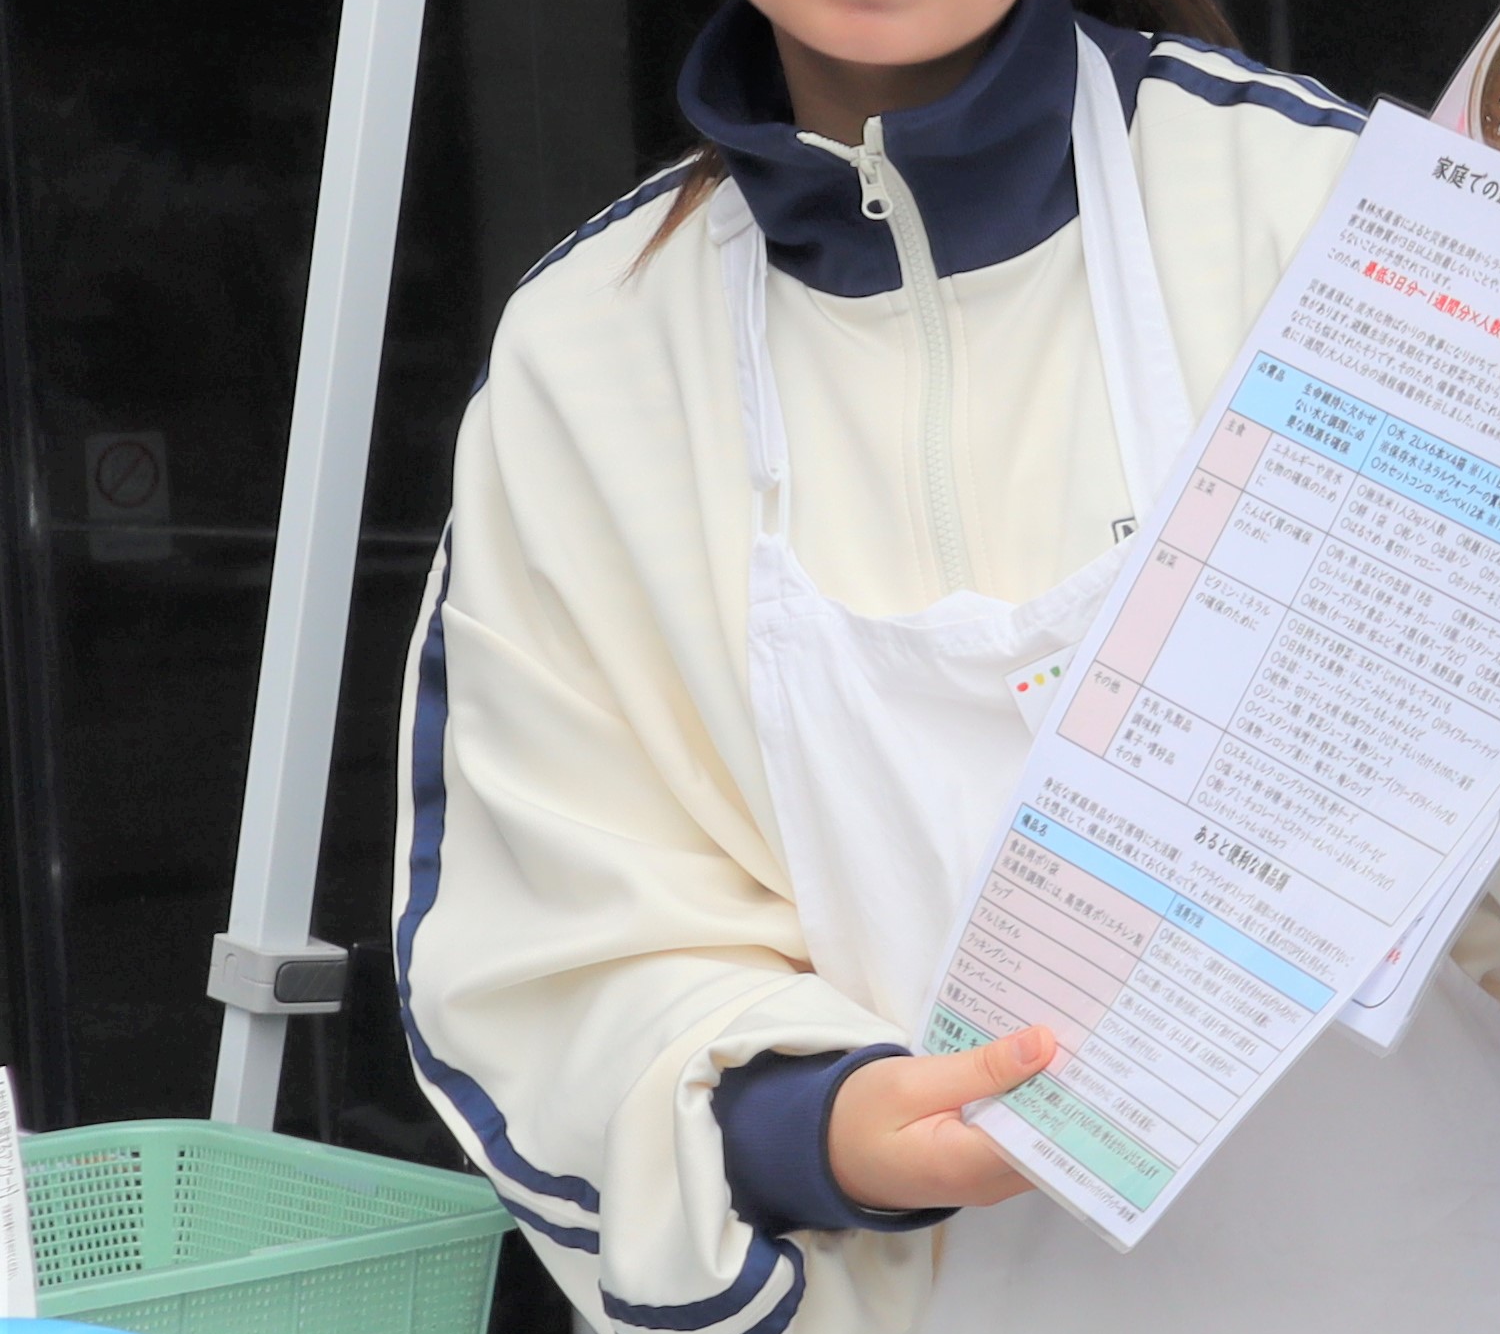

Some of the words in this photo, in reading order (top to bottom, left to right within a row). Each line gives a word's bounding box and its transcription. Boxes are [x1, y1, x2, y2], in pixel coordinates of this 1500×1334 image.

[1292, 397, 1367, 442] ない水と調理に必
[1301, 381, 1377, 426] 生命維持に欠かせ
[1224, 417, 1247, 437] 主食
[1284, 413, 1352, 455] 要な熱源を確保
[1263, 457, 1339, 502] 化物の確保のため
[1270, 441, 1345, 486] エネルギーや炭水
[1193, 475, 1217, 496] 主菜
[1232, 517, 1271, 544] のために
[1240, 500, 1314, 545] たんぱく質の確保
[1155, 549, 1178, 569] 副菜
[1193, 589, 1260, 632] の確保のために
[1202, 573, 1272, 618] ビタミン・ミネラル
[1091, 669, 1122, 694] その他
[1139, 694, 1194, 733] 牛乳・乳製品
[1112, 744, 1143, 768] その他
[1191, 824, 1291, 892] あると便利な備品類
